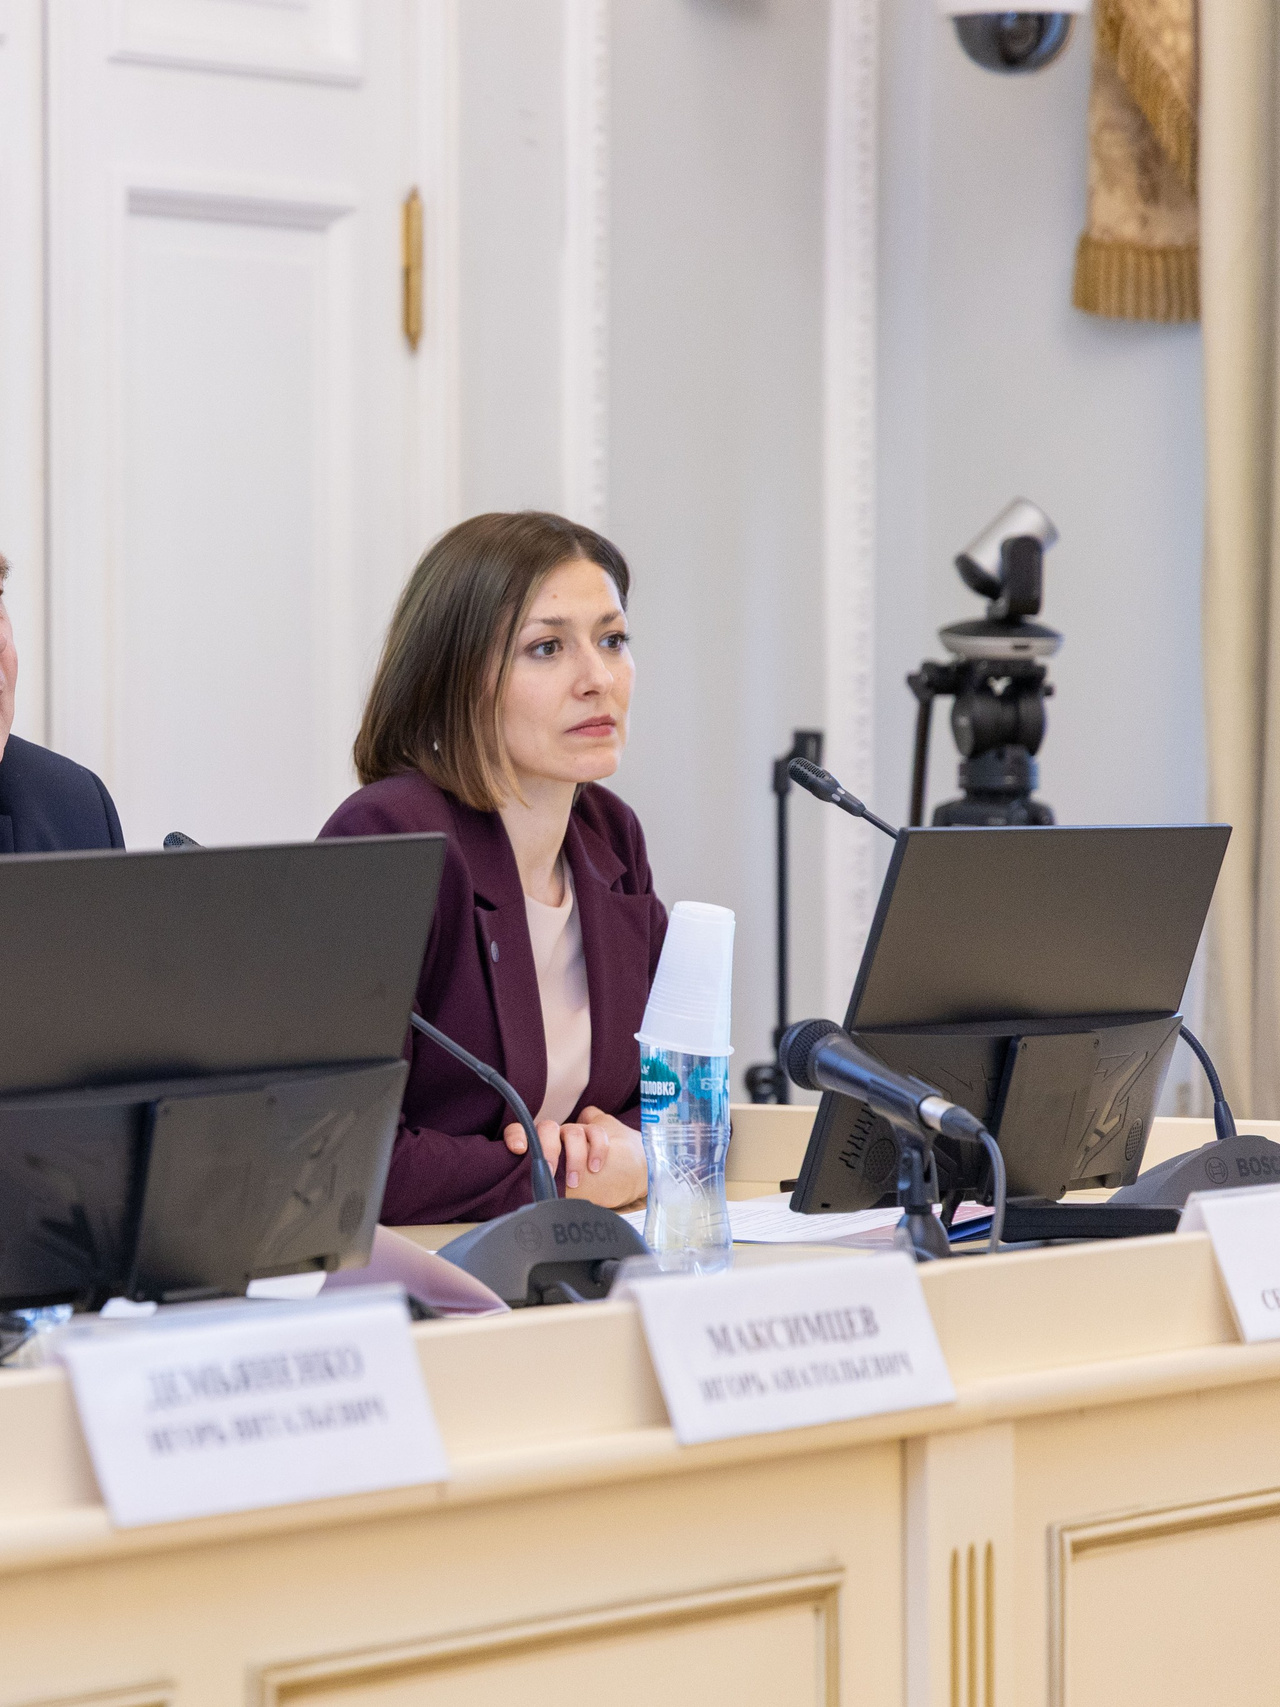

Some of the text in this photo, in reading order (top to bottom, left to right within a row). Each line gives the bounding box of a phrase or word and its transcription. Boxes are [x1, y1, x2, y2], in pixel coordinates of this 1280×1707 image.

[551, 1221, 619, 1245] BOSCH
[706, 1304, 879, 1356] МАКСИМЦЕВ
[699, 1350, 914, 1404] ИГОРЬ АНАТОЛЬЕВИЧ
